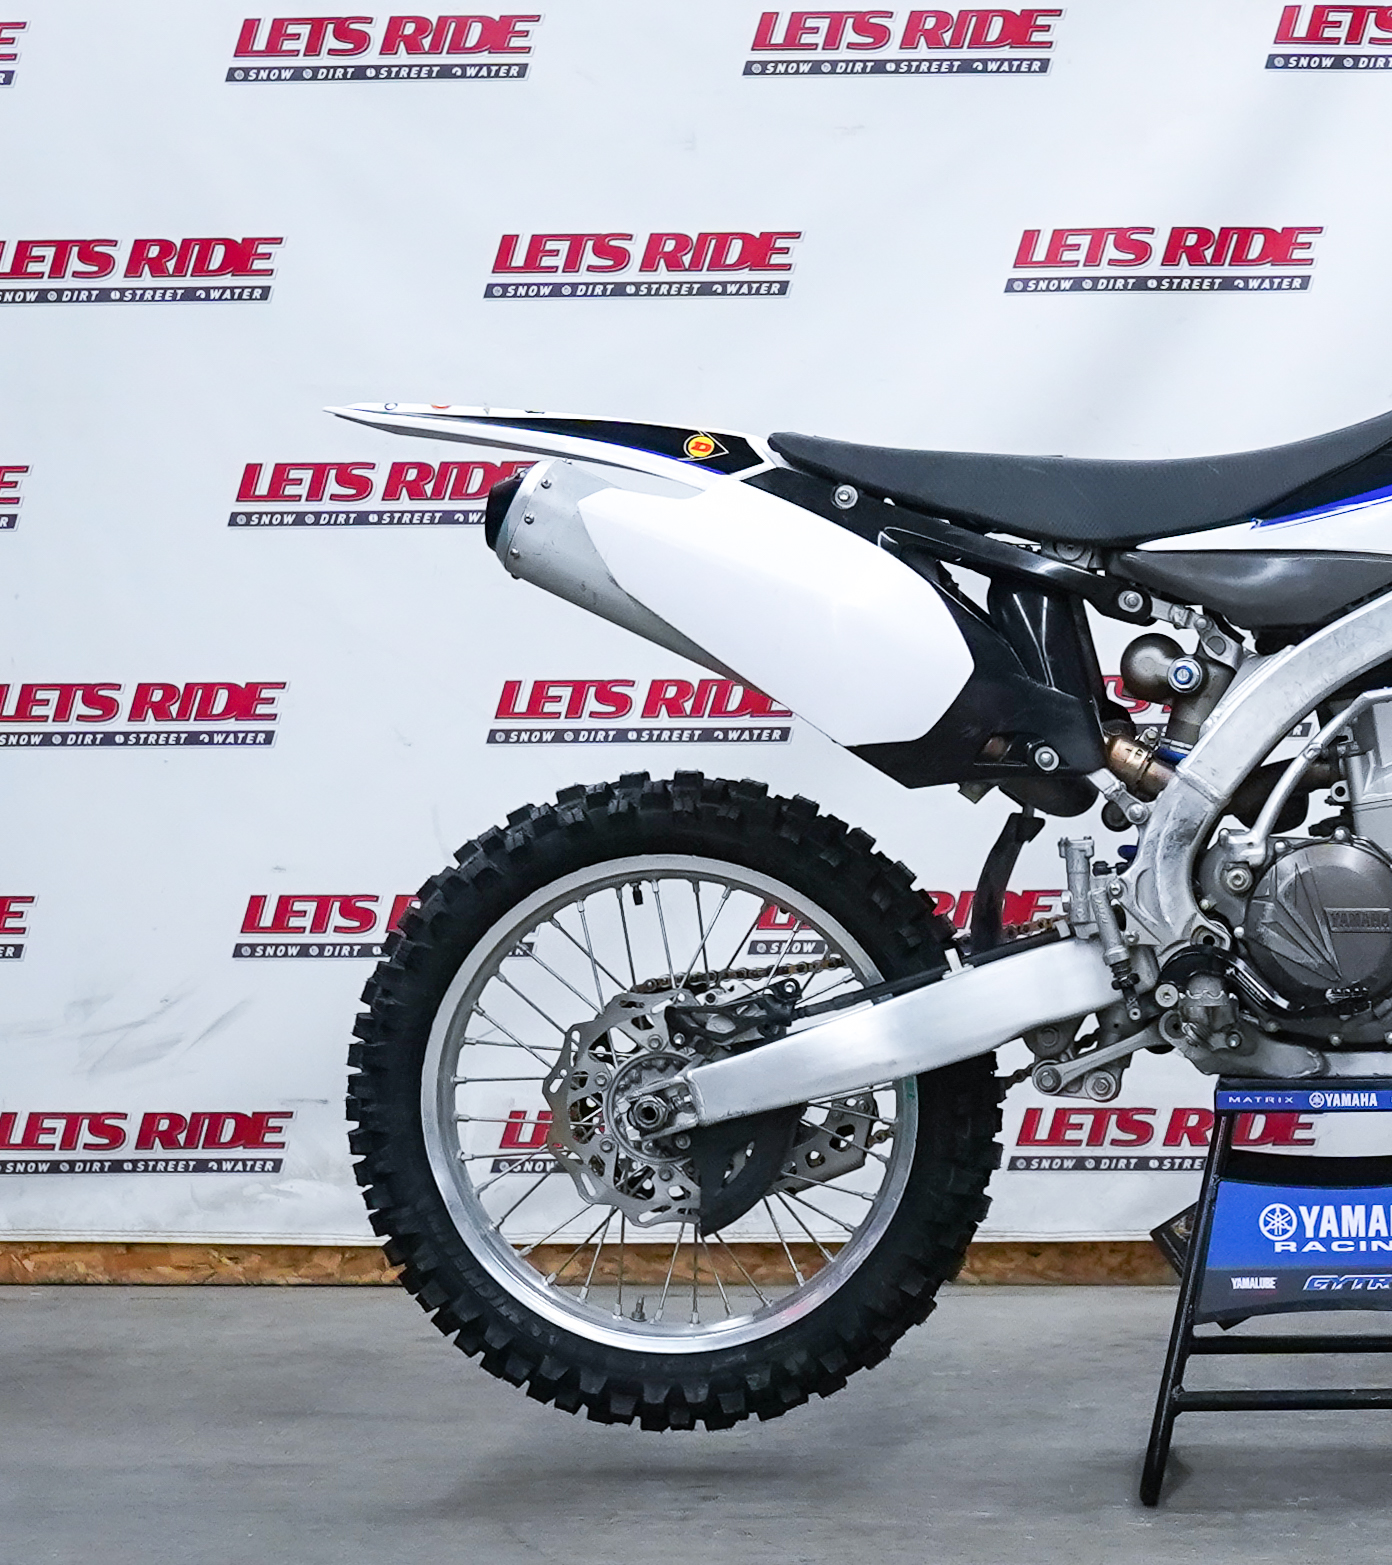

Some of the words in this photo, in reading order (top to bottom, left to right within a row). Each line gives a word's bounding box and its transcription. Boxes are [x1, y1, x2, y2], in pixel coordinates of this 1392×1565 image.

[234, 16, 374, 58] LETS
[380, 15, 540, 55] RIDE
[752, 10, 894, 51] LETS
[900, 10, 1062, 49] RIDE
[765, 62, 813, 74] SNOW
[835, 61, 876, 73] DIRT
[898, 61, 962, 73] STREET
[987, 60, 1041, 73] WATER
[1287, 57, 1335, 69] SNOW
[247, 69, 294, 81] SNOW
[316, 67, 356, 79] DIRT
[378, 66, 442, 79] STREET
[466, 65, 520, 78] WATER
[491, 233, 633, 275] LETS
[639, 232, 801, 272] RIDE
[1013, 227, 1155, 268] LETS
[1161, 227, 1323, 266] RIDE
[124, 238, 282, 278] RIDE
[504, 286, 552, 298] SNOW
[574, 284, 615, 297] DIRT
[637, 283, 701, 296] STREET
[726, 282, 780, 295] WATER
[1026, 279, 1074, 291] SNOW
[1096, 278, 1137, 290] DIRT
[1159, 278, 1223, 290] STREET
[1248, 277, 1302, 290] WATER
[60, 290, 101, 302] DIRT
[122, 289, 185, 301] STREET
[209, 287, 262, 301] WATER
[235, 461, 376, 502] LETS
[248, 513, 296, 525] SNOW
[318, 512, 358, 524] DIRT
[380, 512, 443, 524] STREET
[128, 683, 287, 721] RIDE
[494, 679, 635, 720] LETS
[64, 733, 104, 744] DIRT
[126, 733, 189, 744] STREET
[213, 732, 266, 744] WATER
[507, 731, 555, 743] SNOW
[577, 730, 617, 742] DIRT
[639, 730, 702, 742] STREET
[727, 729, 781, 742] WATER
[241, 894, 380, 934] LETS
[253, 944, 301, 957] SNOW
[322, 944, 362, 956] DIRT
[1325, 1093, 1378, 1107] YAMAHA
[135, 1112, 294, 1150] RIDE
[1016, 1107, 1157, 1147] LETS
[3, 1163, 50, 1174] SNOW
[71, 1162, 111, 1173] DIRT
[133, 1162, 196, 1173] STREET
[220, 1161, 273, 1173] WATER
[1029, 1158, 1077, 1170] SNOW
[1098, 1157, 1139, 1169] DIRT
[1162, 1158, 1204, 1170] STRE
[1231, 1277, 1278, 1289] YAMALUBE
